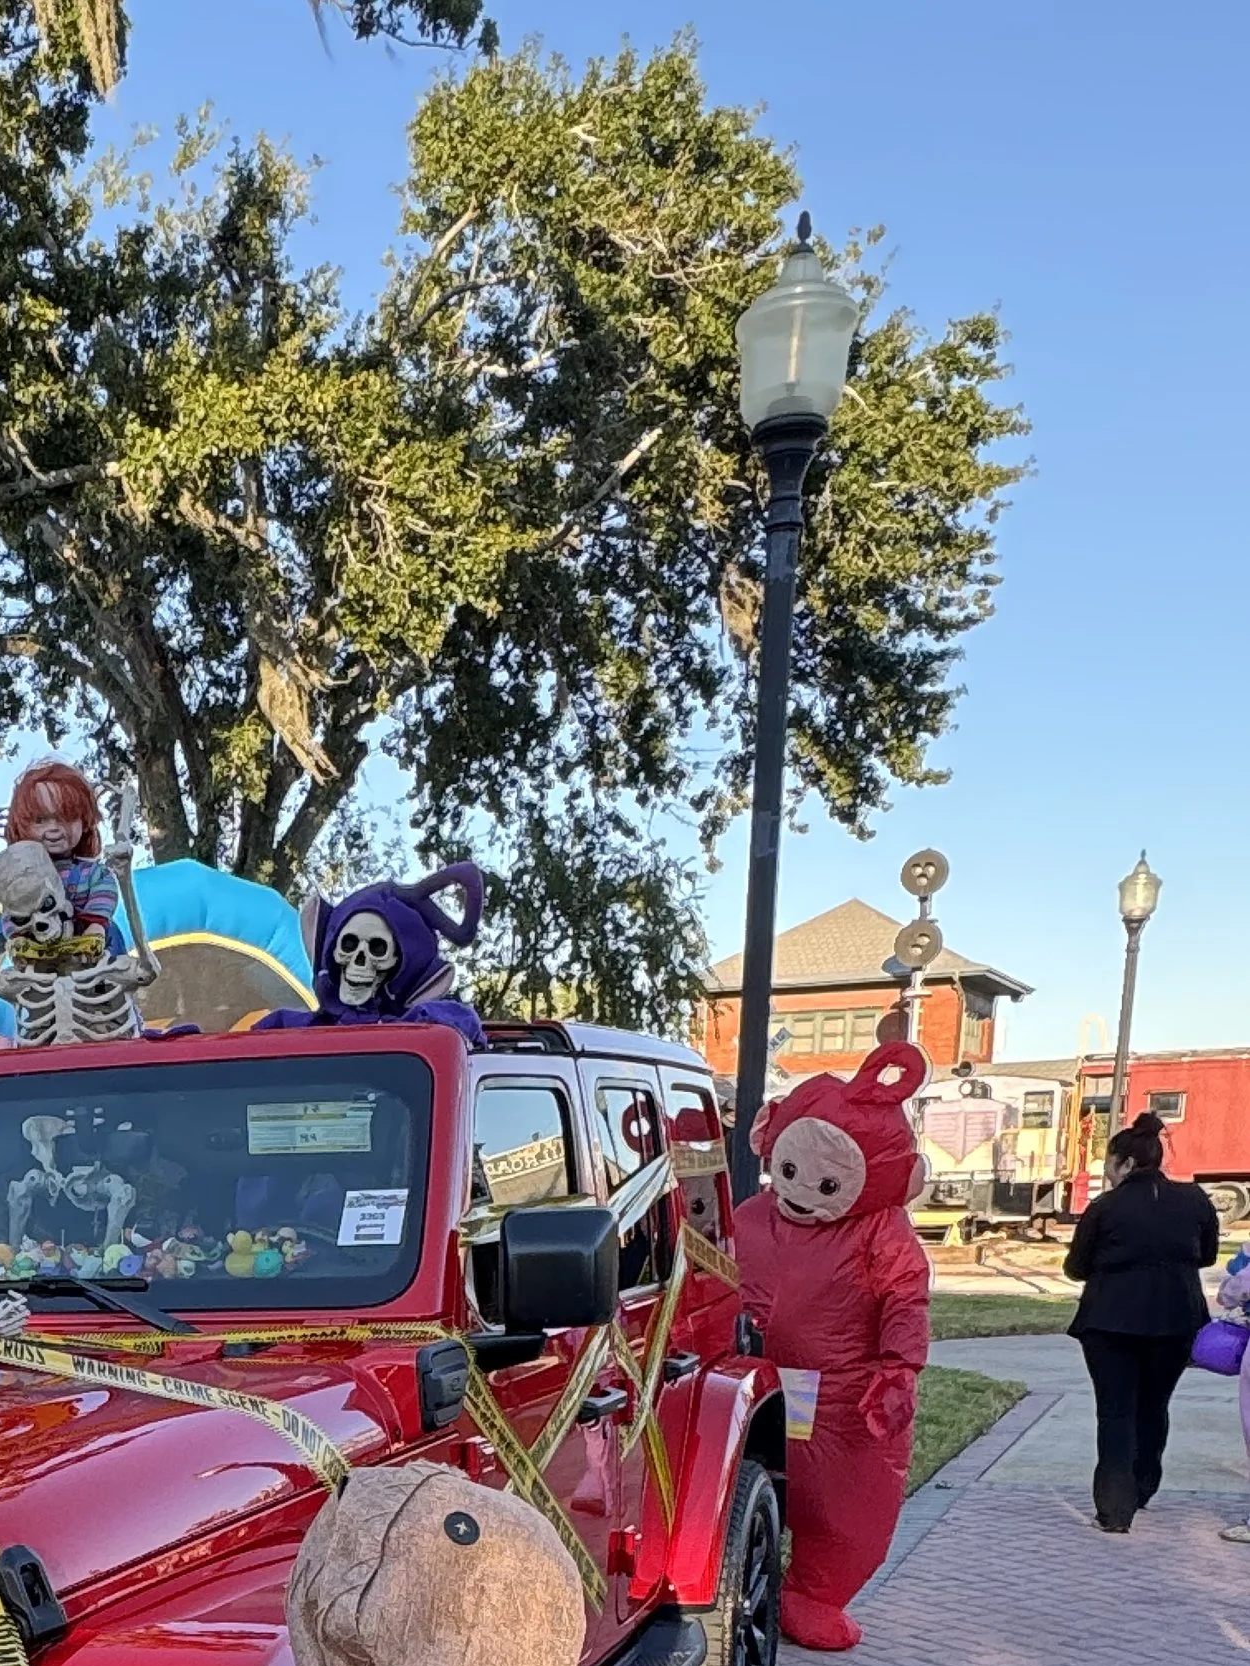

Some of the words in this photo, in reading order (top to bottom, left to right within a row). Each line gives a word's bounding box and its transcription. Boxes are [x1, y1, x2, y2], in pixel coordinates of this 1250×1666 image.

[71, 1355, 147, 1388] WARNING
[161, 1376, 214, 1402] CRIME
[218, 1390, 269, 1418] SCENE
[282, 1409, 300, 1437] DO
[301, 1420, 324, 1460] NOT
